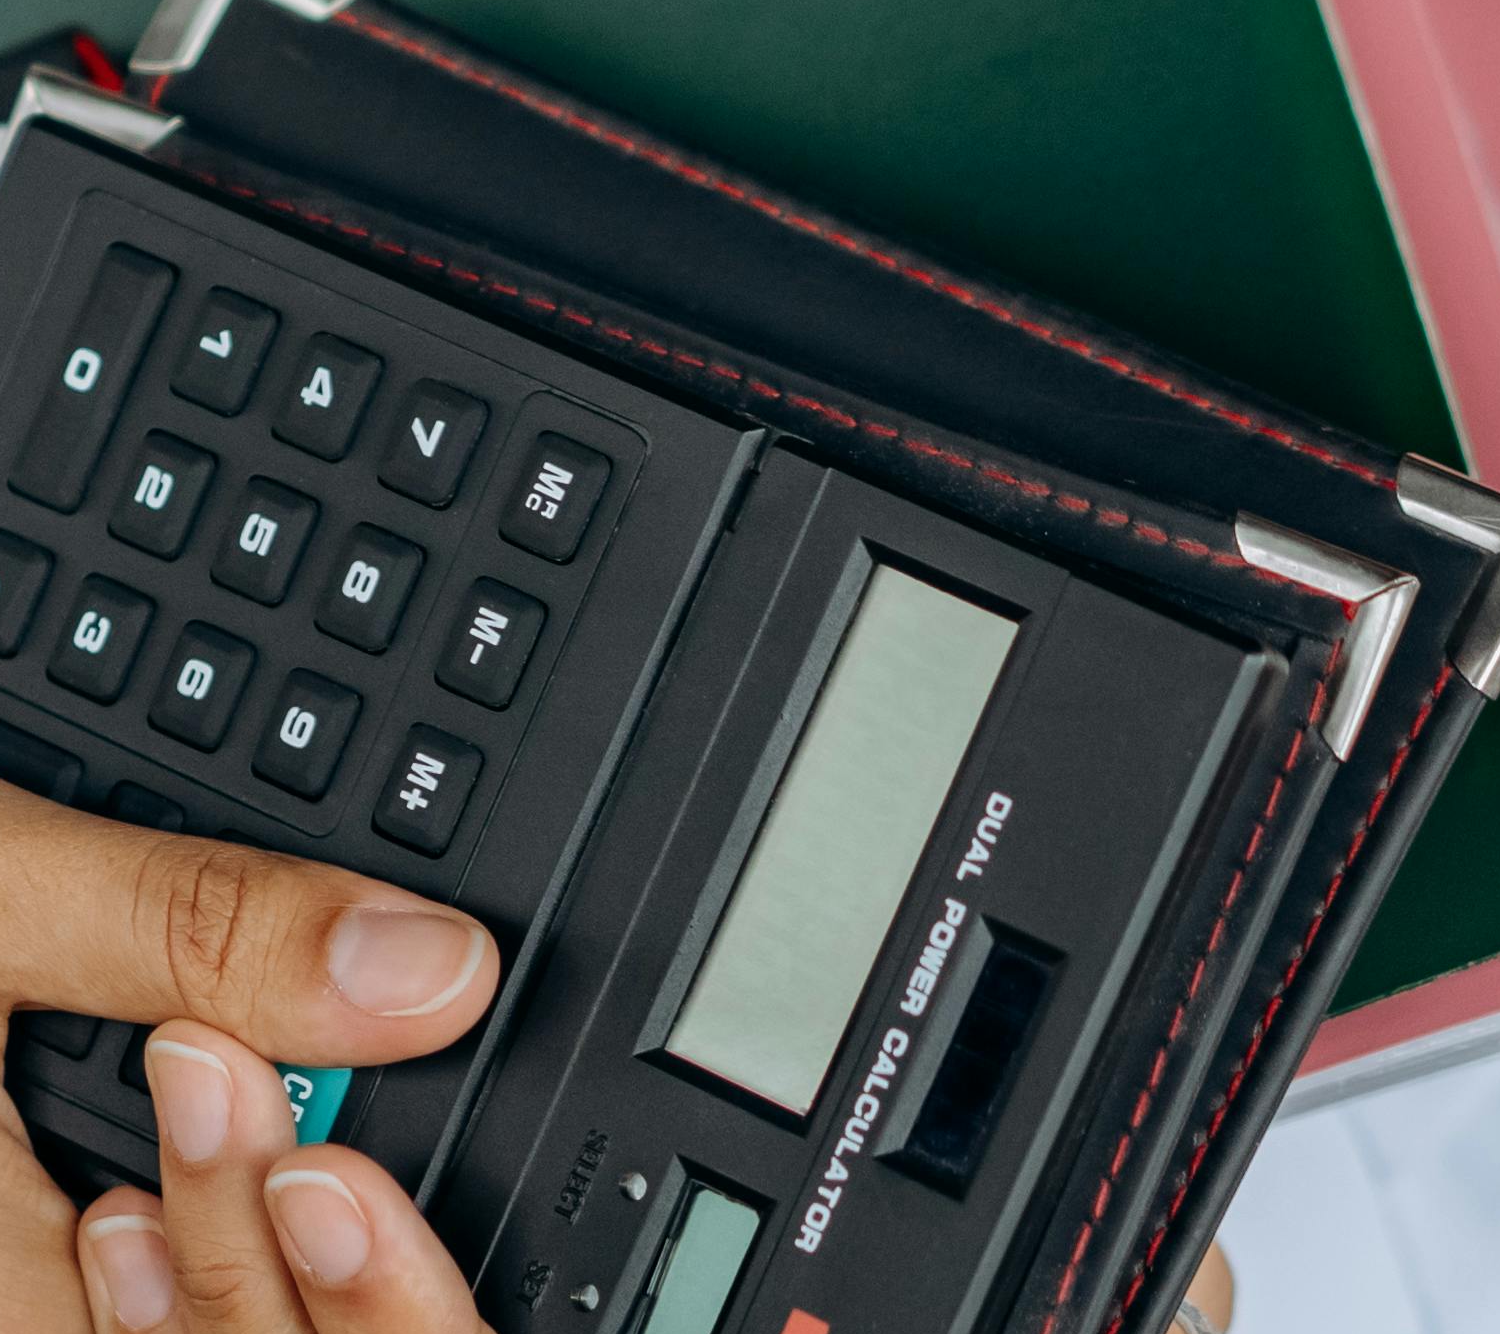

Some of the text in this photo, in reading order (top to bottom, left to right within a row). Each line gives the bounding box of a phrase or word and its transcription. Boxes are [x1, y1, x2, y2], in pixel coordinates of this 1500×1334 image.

[200, 330, 231, 357] 1
[65, 349, 100, 390] 0
[300, 367, 332, 408] 4
[411, 417, 446, 458] 7
[135, 466, 173, 508] 2
[240, 514, 278, 556] 5
[342, 561, 380, 603] 8
[74, 611, 110, 652] 3
[469, 607, 508, 665] M-
[177, 659, 214, 699] 6
[279, 707, 316, 748] 9
[400, 753, 445, 811] M+
[794, 791, 1013, 1253] DUAL POWER CALCULATOR
[555, 1129, 608, 1226] SELECT
[517, 1259, 553, 1312] SET
